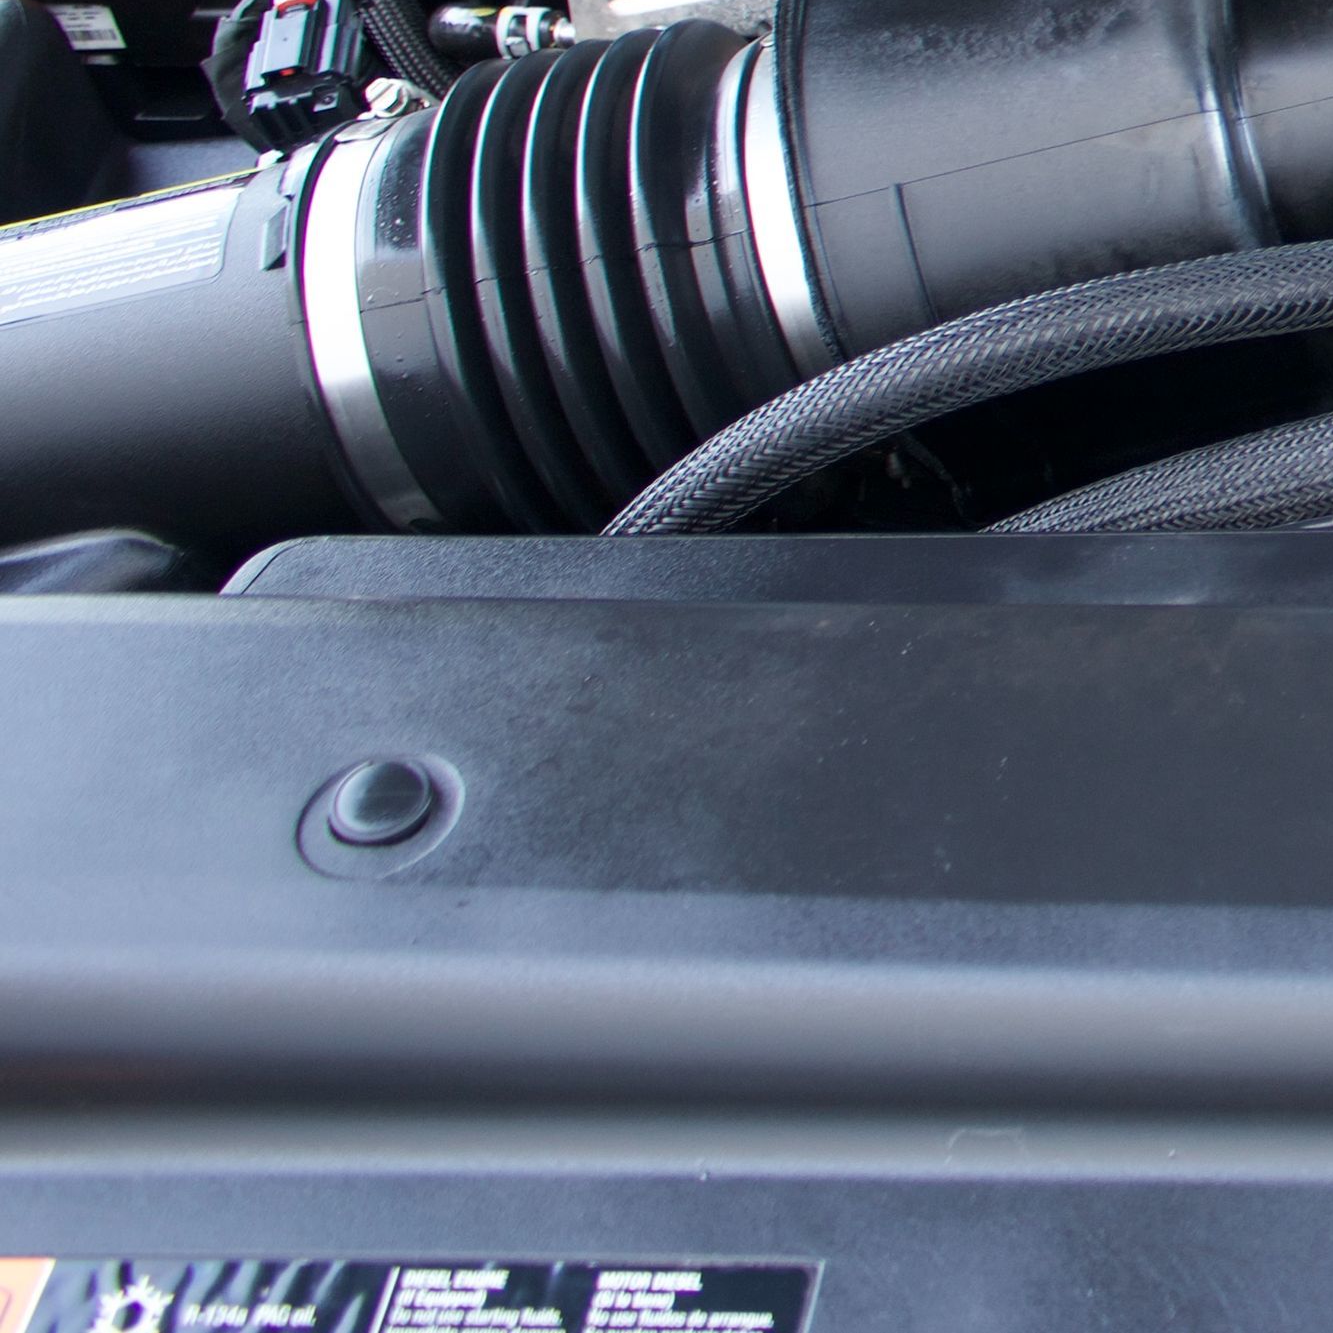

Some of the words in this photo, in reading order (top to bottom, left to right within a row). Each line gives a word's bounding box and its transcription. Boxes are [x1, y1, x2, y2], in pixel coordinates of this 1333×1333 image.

[401, 1269, 453, 1289] DIESEL
[452, 1269, 510, 1290] ENGINE
[597, 1271, 653, 1290] MOTOR
[650, 1271, 703, 1291] DIESEL
[183, 1303, 249, 1327] R-134a
[251, 1303, 292, 1327] PAG
